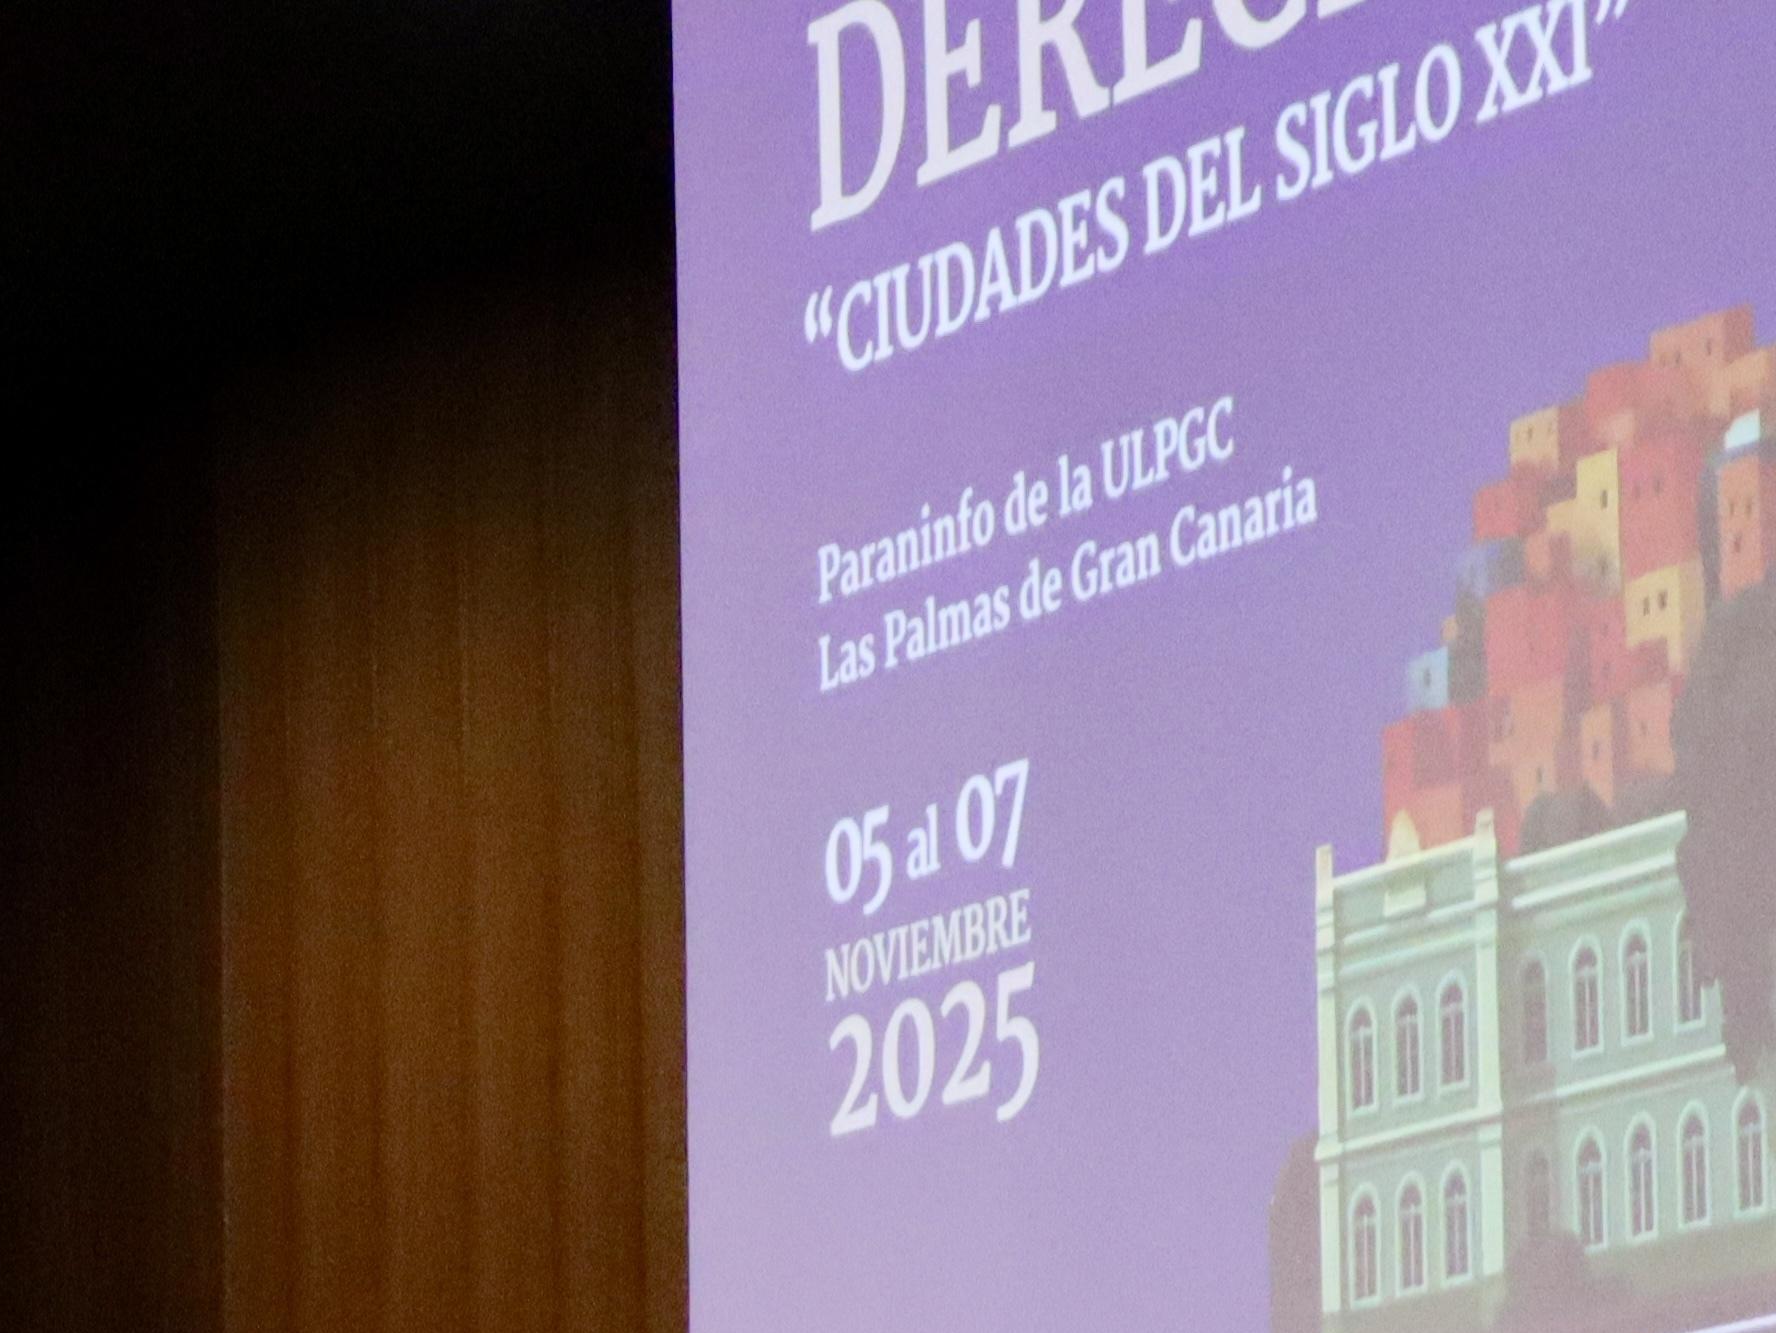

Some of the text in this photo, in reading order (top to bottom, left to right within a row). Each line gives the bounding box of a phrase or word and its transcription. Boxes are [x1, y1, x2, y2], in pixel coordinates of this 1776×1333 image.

[1143, 126, 1261, 255] DEL
[1276, 42, 1463, 201] SIGLO
[818, 396, 1234, 602] Paraninfo de la ULPGC
[818, 465, 1317, 691] Las Palmas de Gran Canaria
[824, 758, 1029, 916] 05 al 07
[825, 888, 1031, 1002] NOVIEMBRE
[829, 961, 1040, 1137] 2025
